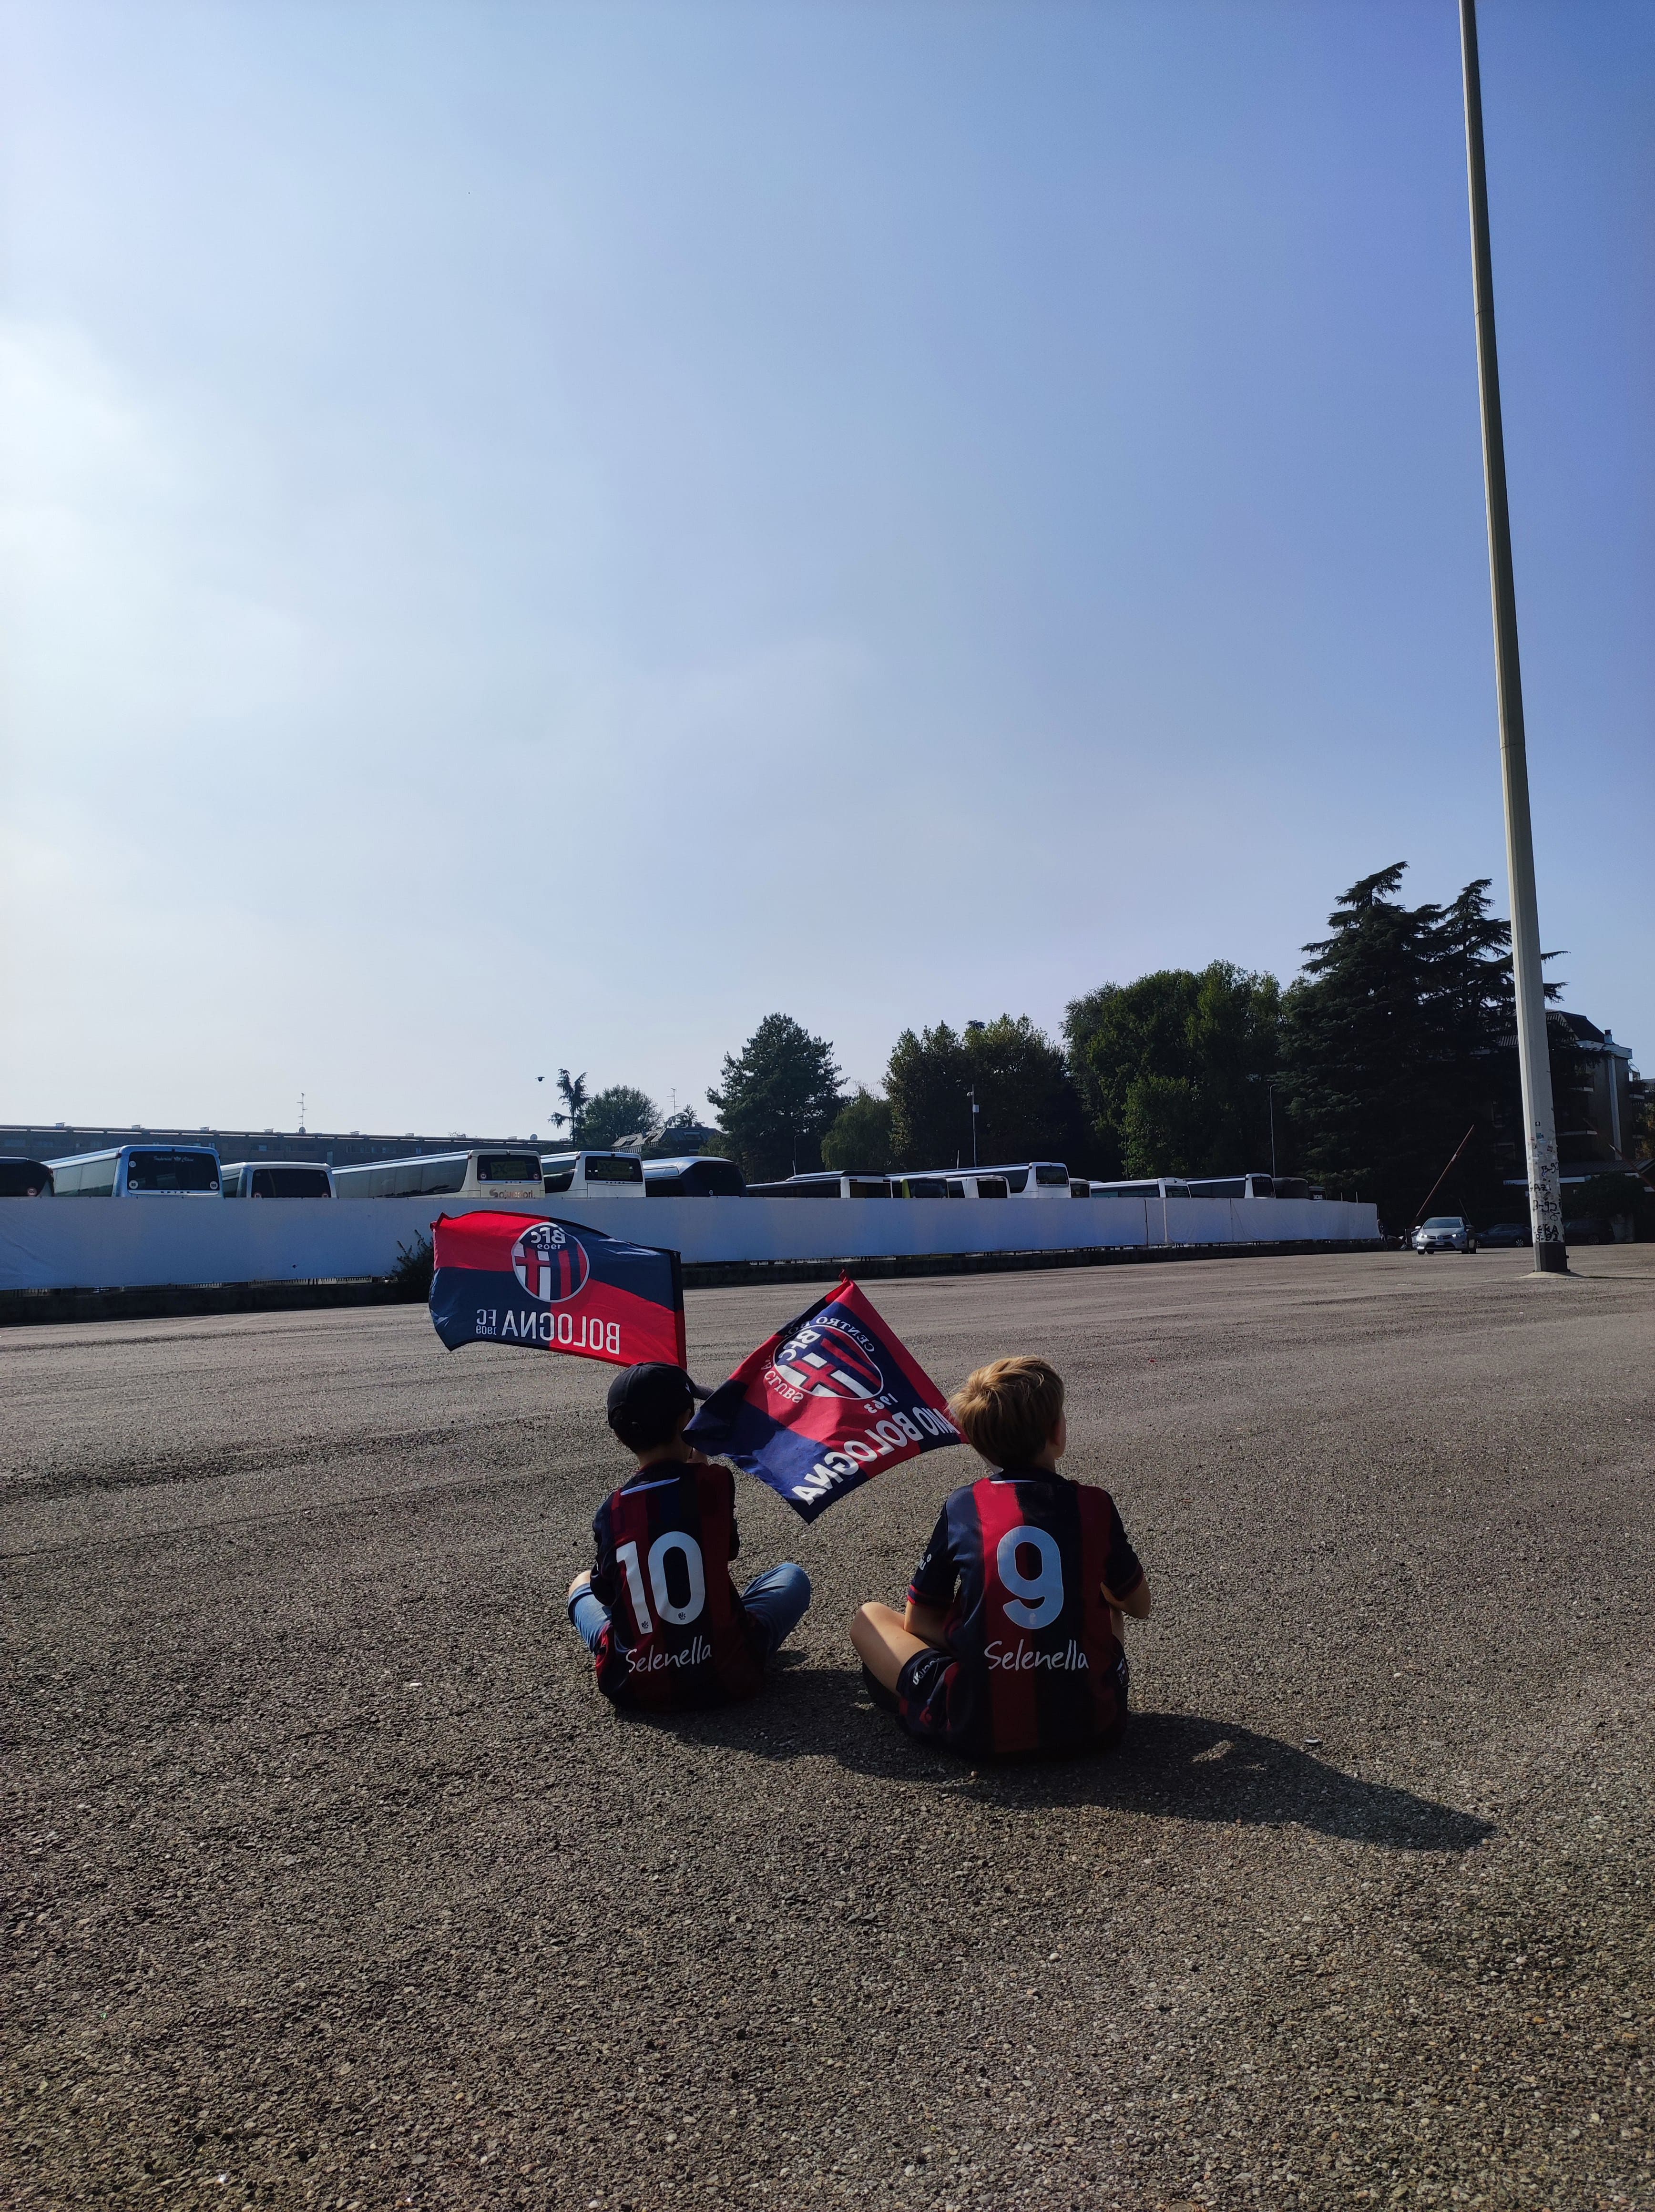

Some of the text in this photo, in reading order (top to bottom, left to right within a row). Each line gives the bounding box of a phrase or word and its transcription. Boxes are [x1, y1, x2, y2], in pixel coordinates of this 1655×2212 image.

[616, 1531, 705, 1635] 10
[996, 1525, 1064, 1629] 9
[625, 1635, 712, 1673] Selenella
[984, 1639, 1090, 1671] Selenella
